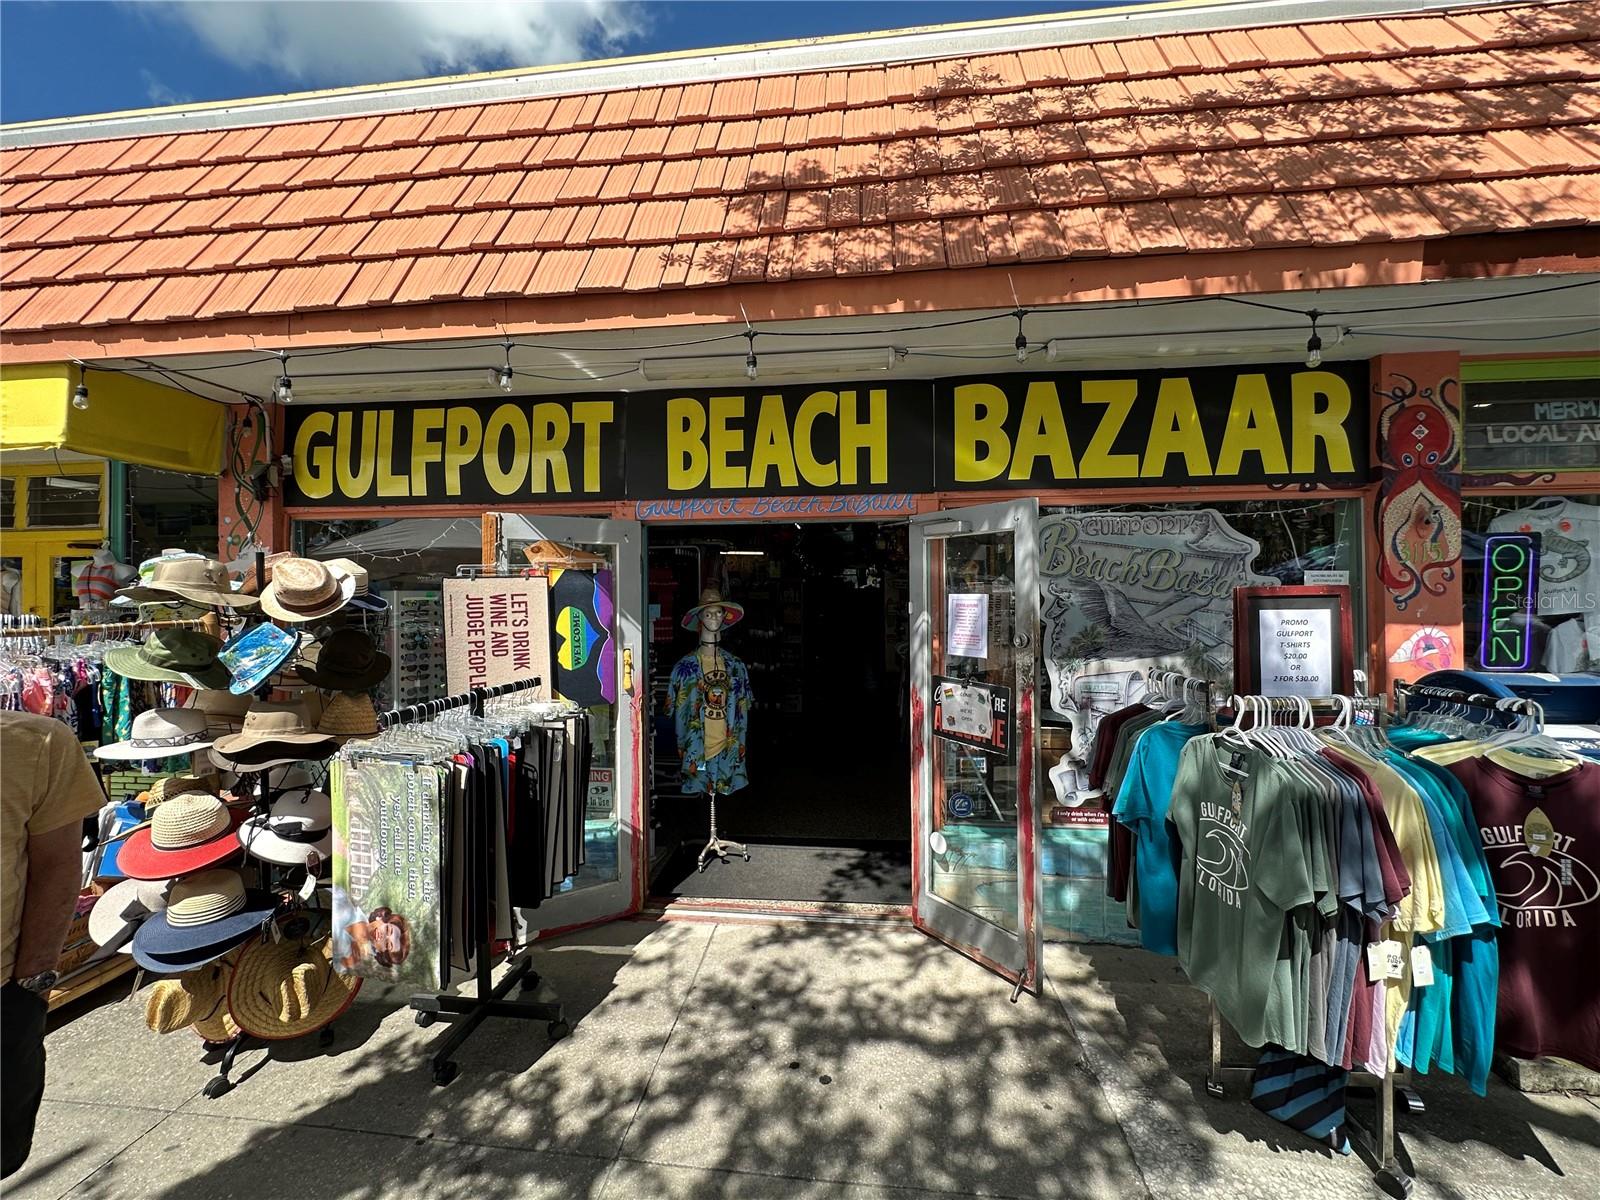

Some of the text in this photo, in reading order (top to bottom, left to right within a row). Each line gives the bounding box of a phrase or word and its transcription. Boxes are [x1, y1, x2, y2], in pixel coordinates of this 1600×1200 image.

[1534, 399, 1600, 421] MERM
[294, 371, 1356, 500] GULFPORT BEACH BAZAAR
[1486, 424, 1569, 444] LOCAL
[635, 497, 744, 520] Gulfport
[750, 495, 824, 516] Beach
[1082, 516, 1190, 536] GULFPORT
[1039, 521, 1233, 597] Beach Baza
[466, 594, 485, 637] JUDGE
[1490, 543, 1525, 663] OPEN
[489, 593, 509, 657] WINE AND
[510, 593, 531, 671] LET'S DRINK
[573, 611, 582, 666] WELCOME
[1283, 652, 1308, 660] $20.00
[405, 771, 418, 812] porch
[377, 799, 390, 869] outdoorsy.
[394, 825, 405, 850] call
[407, 816, 418, 862] counts
[419, 775, 434, 902] If drinking on the
[1480, 825, 1576, 853] GULFRT
[394, 855, 403, 876] me
